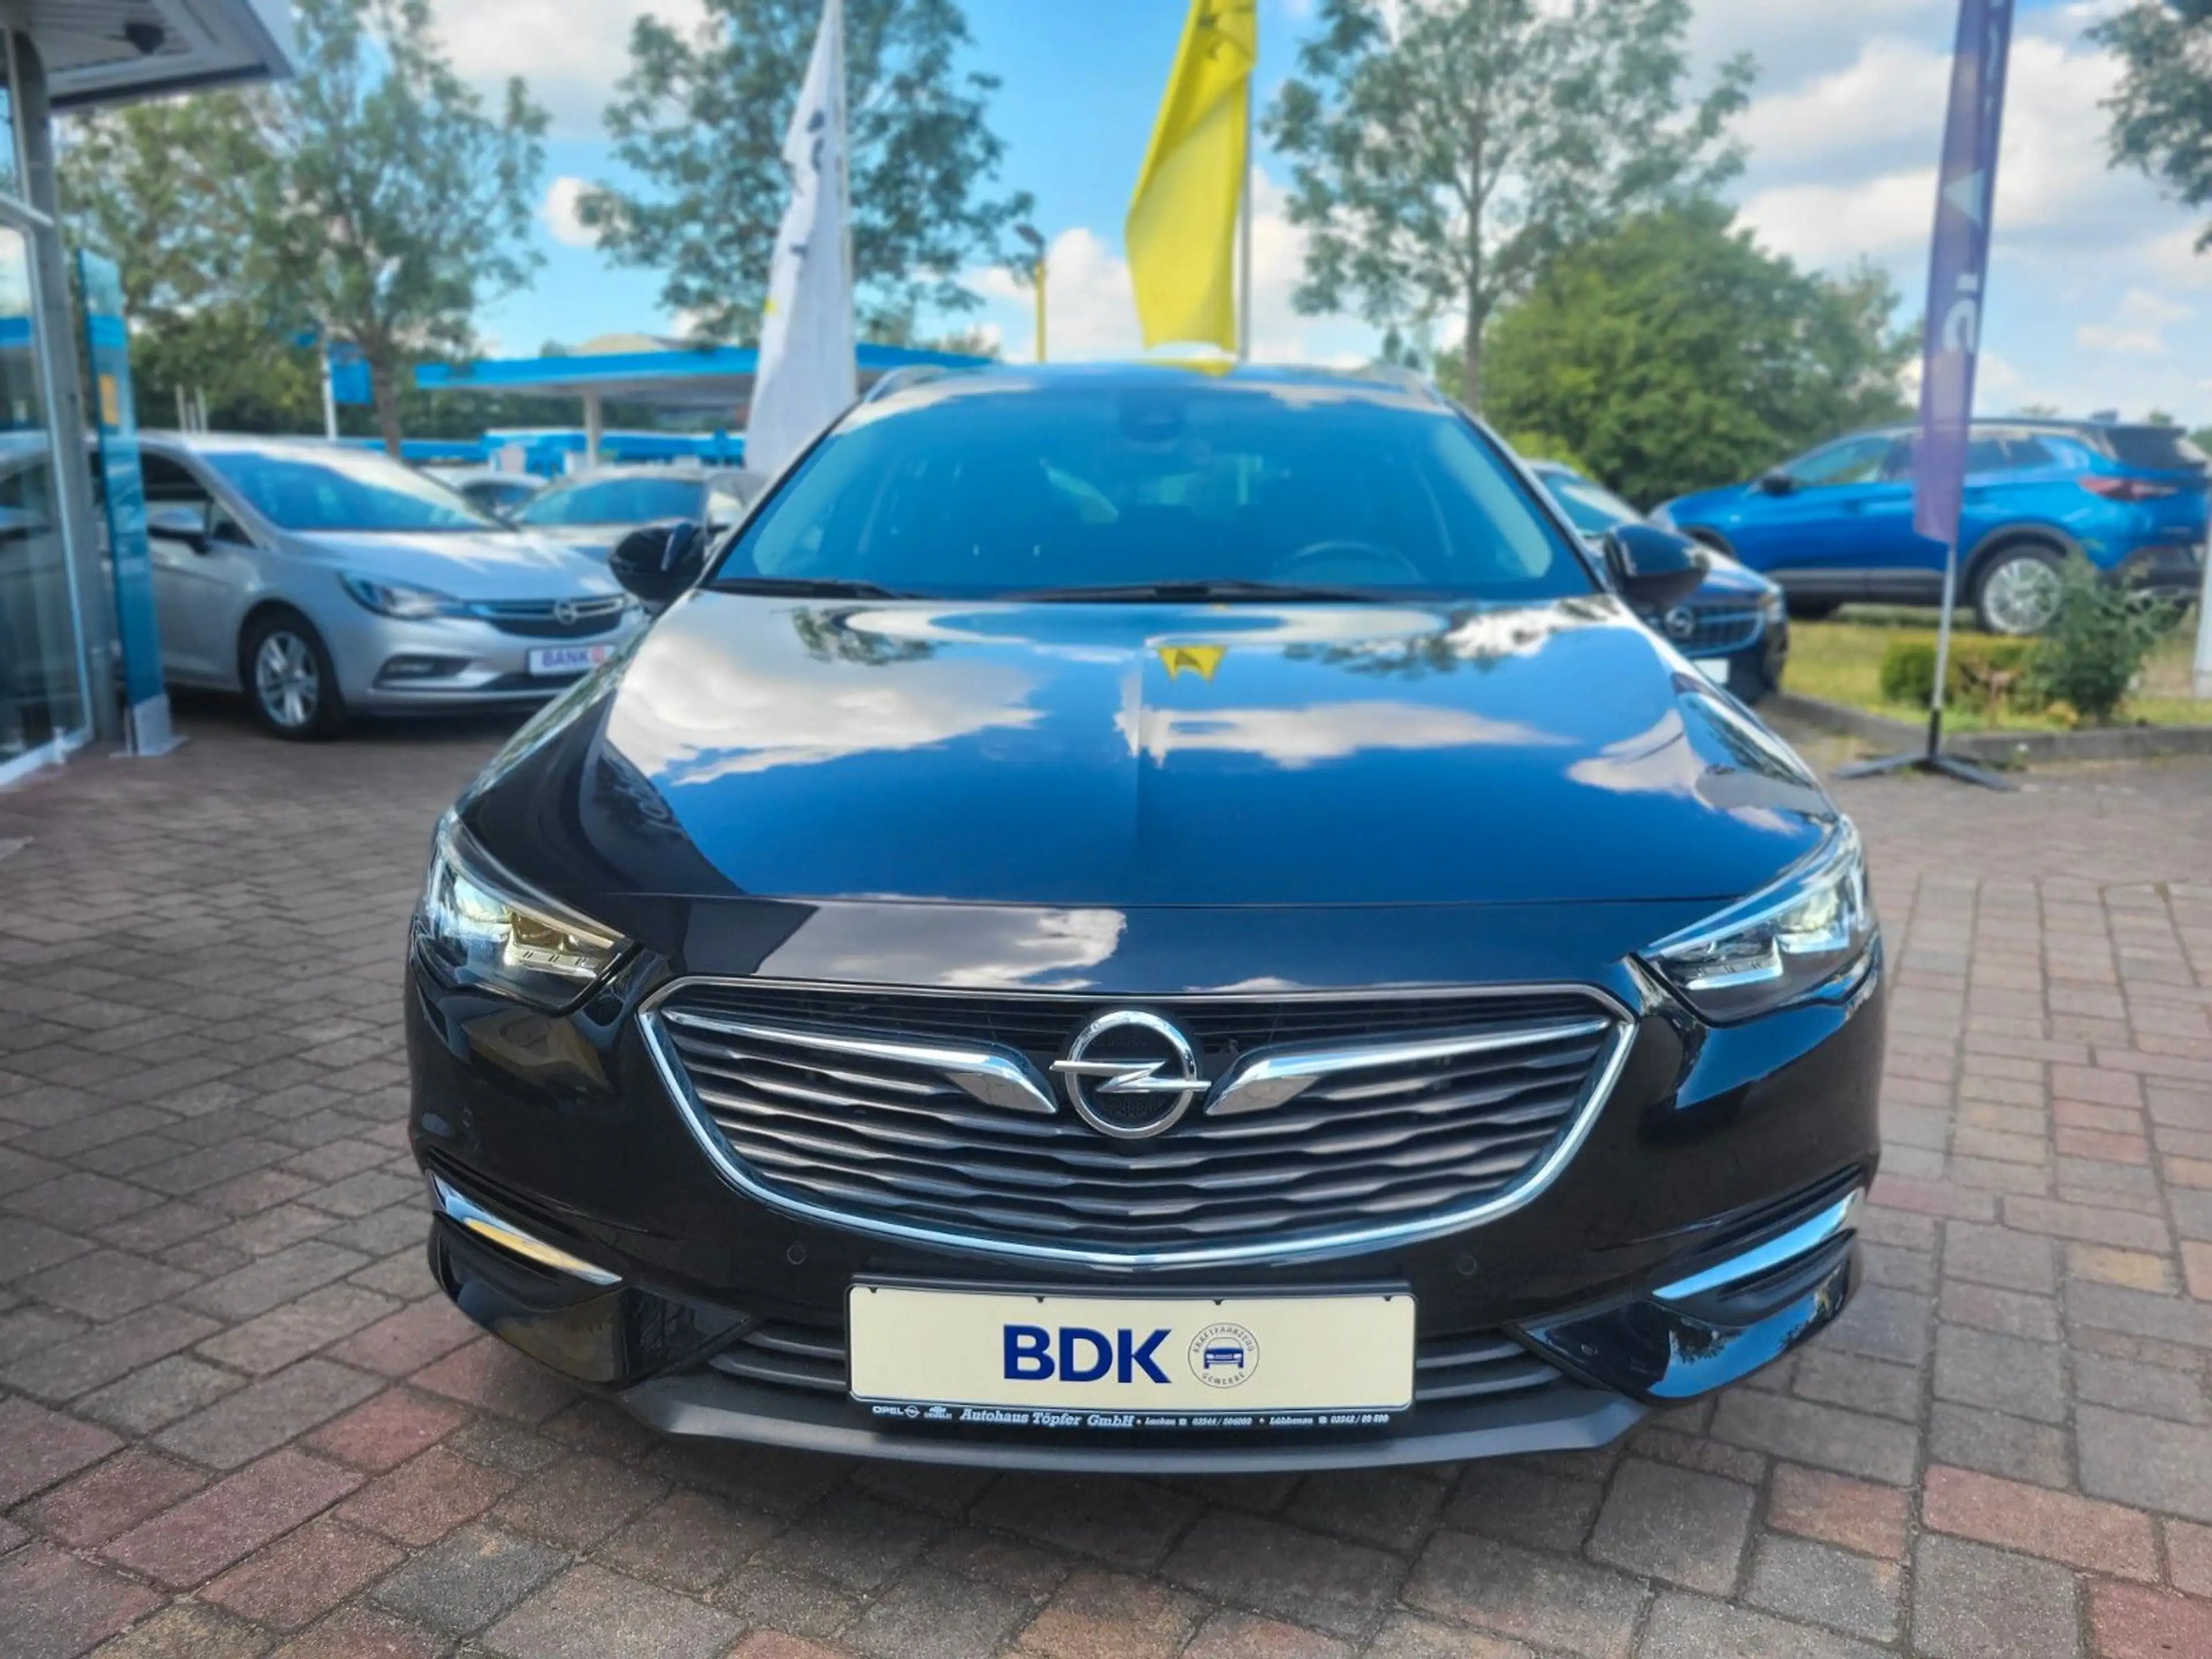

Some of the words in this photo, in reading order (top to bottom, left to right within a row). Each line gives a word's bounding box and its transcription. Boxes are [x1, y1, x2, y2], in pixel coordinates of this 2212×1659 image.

[1003, 1324, 1172, 1383] BDK
[872, 1406, 903, 1415] OPEL
[959, 1408, 1029, 1423] Autohaus
[1033, 1411, 1082, 1427] Töpfer
[1087, 1414, 1134, 1426] GmbH
